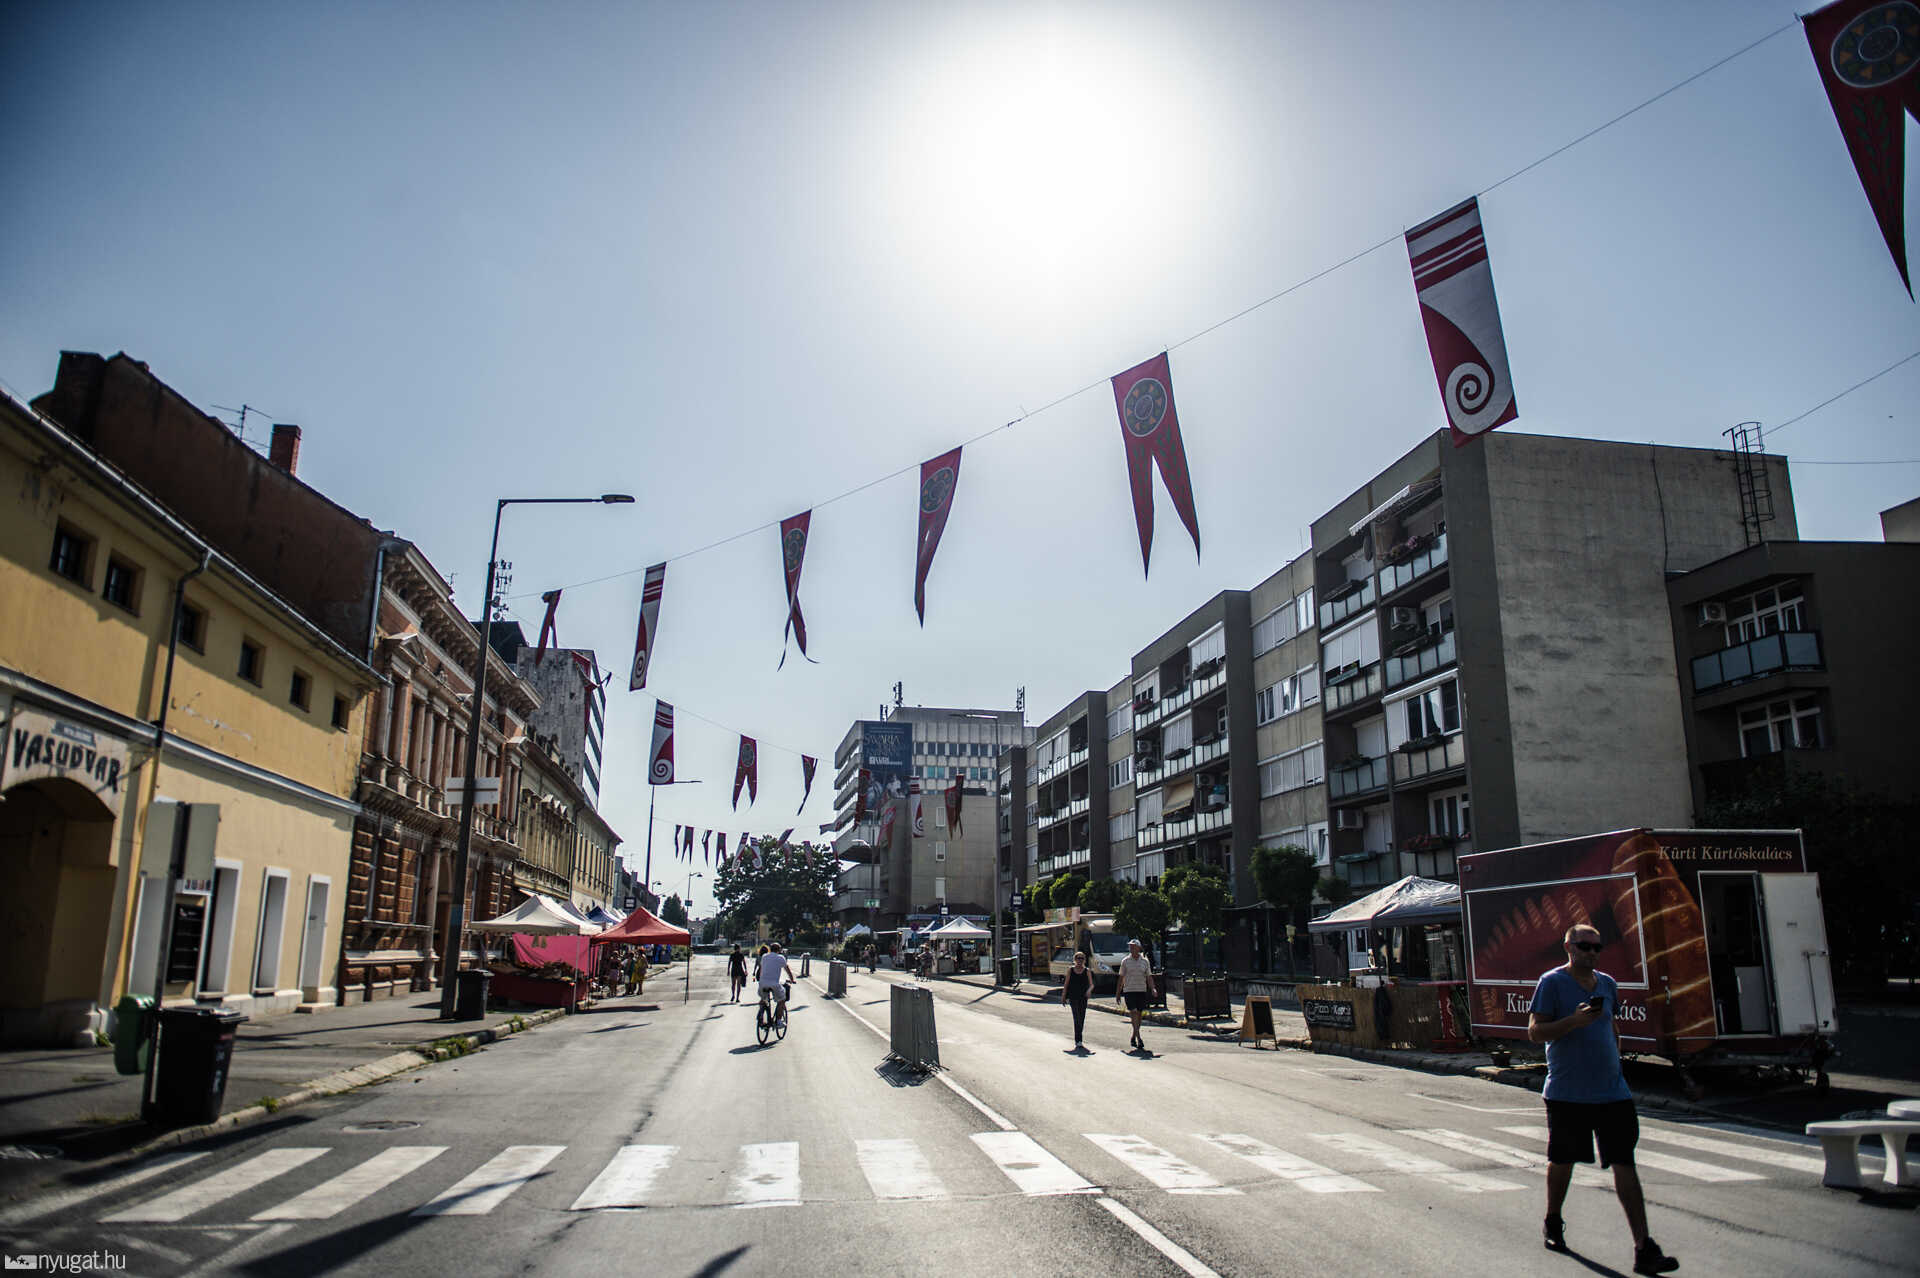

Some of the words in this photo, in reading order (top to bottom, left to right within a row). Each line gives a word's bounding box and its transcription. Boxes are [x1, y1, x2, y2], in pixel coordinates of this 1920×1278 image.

[13, 728, 120, 794] VASUDVAR
[1658, 846, 1697, 860] Kürti
[1702, 845, 1793, 860] Kürtőskalács
